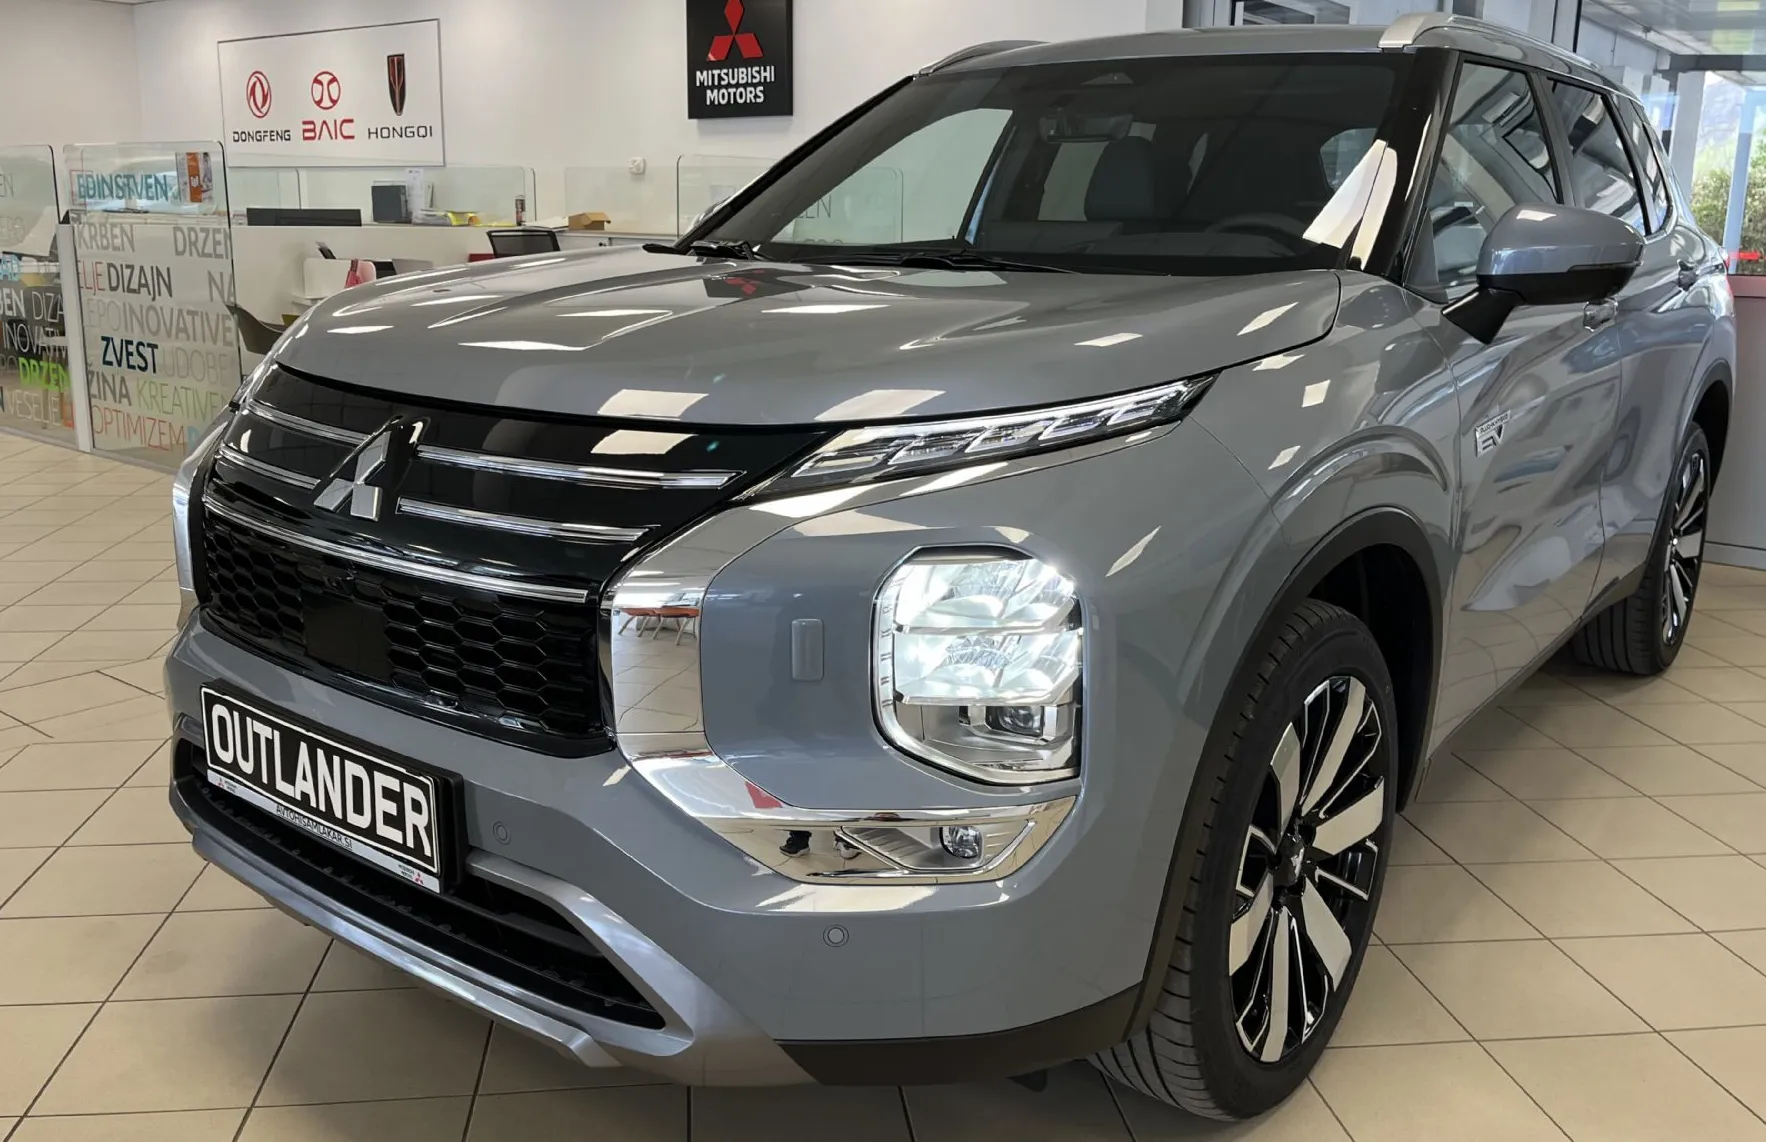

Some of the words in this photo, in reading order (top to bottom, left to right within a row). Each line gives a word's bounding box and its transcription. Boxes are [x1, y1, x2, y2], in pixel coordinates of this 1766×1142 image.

[695, 65, 775, 87] MITSUBISHI
[706, 86, 765, 106] MOTORS
[232, 129, 292, 143] DONGFENG
[302, 119, 355, 141] BAIC
[367, 125, 433, 140] HONGQI
[107, 262, 173, 302] DIZAJN
[101, 335, 159, 375] ZVEST
[92, 404, 187, 453] OPTIMIZEM
[211, 703, 433, 858] OUTLANDER
